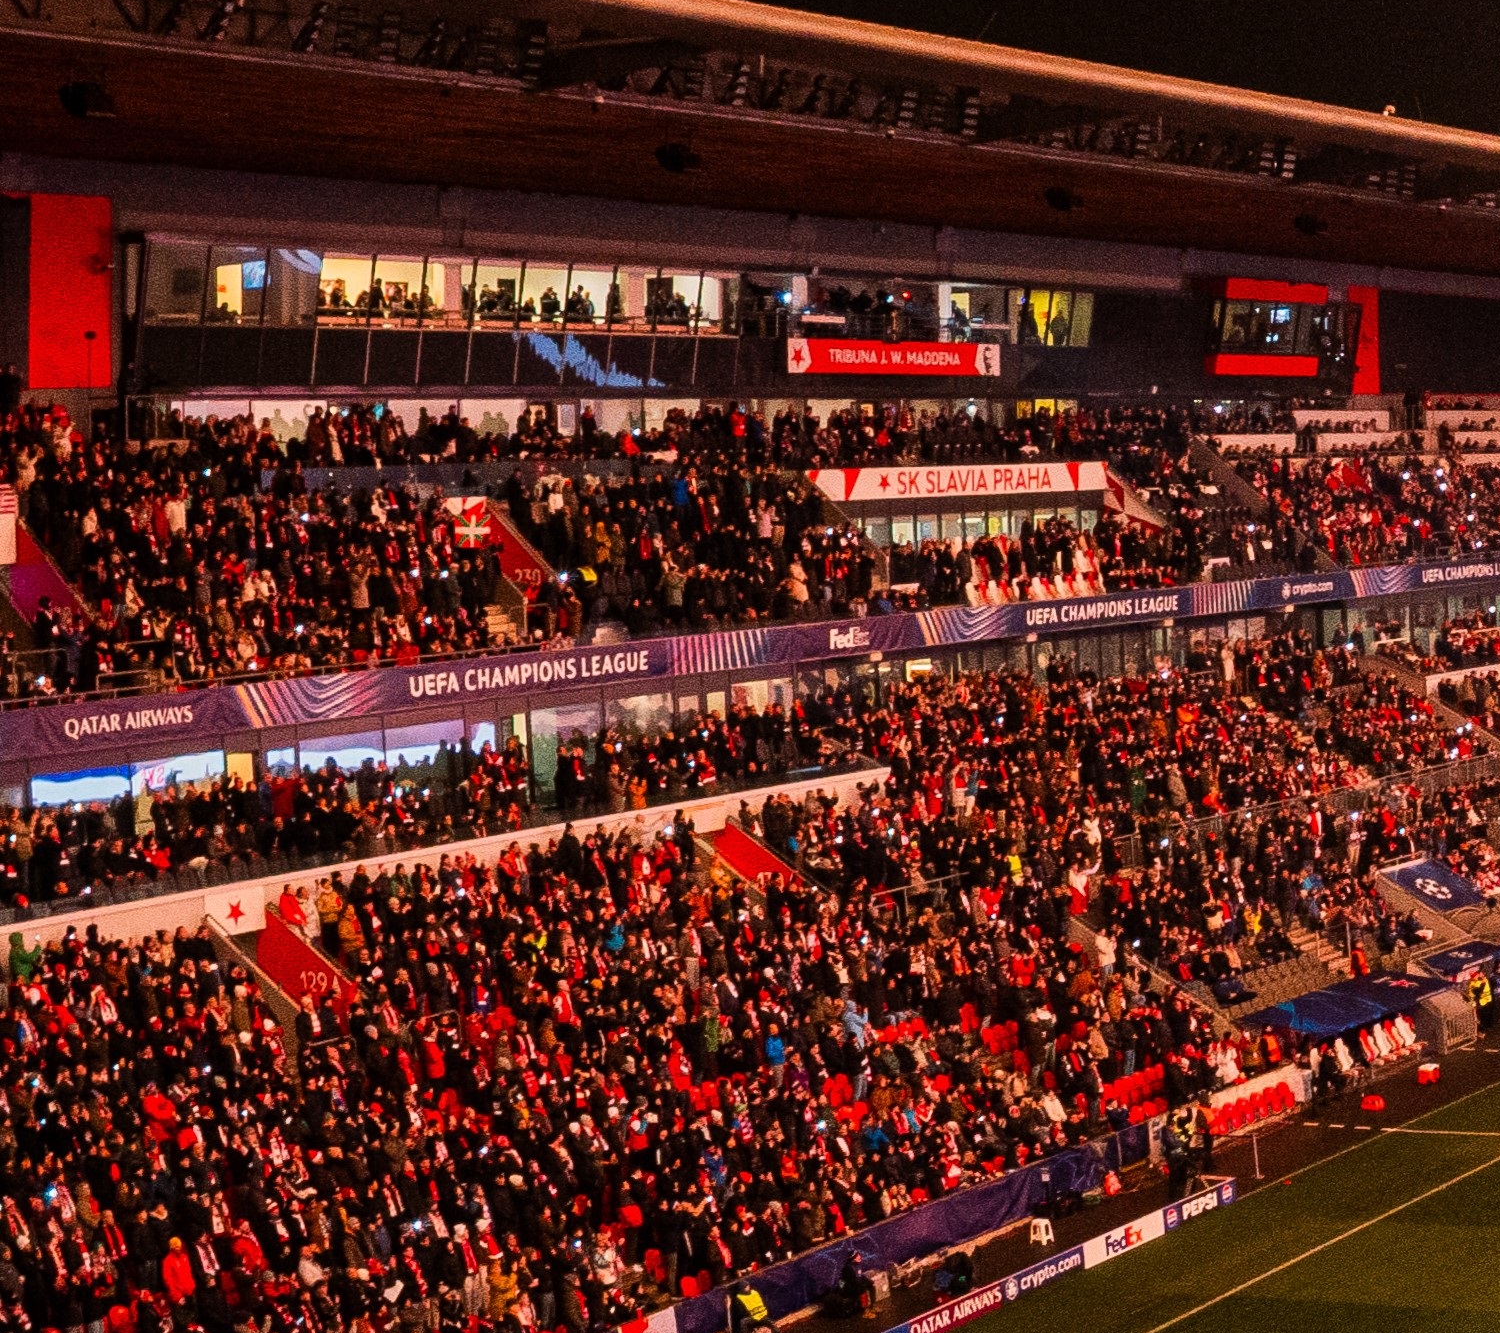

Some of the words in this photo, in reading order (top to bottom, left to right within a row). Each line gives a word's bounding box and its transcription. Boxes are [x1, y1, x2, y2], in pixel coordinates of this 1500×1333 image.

[828, 348, 878, 365] TRIBUNA
[890, 350, 904, 365] W.
[906, 350, 961, 366] MADDENA
[897, 470, 921, 495] SK
[925, 469, 988, 494] SLAVIA
[993, 467, 1051, 491] PRAHA
[1026, 608, 1058, 626] UEFA
[1060, 599, 1133, 623] CHAMPIONS
[1135, 594, 1179, 615] LEAGUE
[409, 671, 460, 698] UEFA
[464, 657, 577, 692] CHAMPIONS
[581, 650, 650, 678] LEAGUE
[64, 713, 122, 741] QATAR
[124, 705, 194, 730] AIRWAYS
[299, 970, 328, 993] 129
[1181, 1191, 1218, 1221] PEPSI
[1105, 1225, 1143, 1257] FedEx
[1020, 1252, 1081, 1292] crypto.com
[952, 1285, 1003, 1321] AIRWAYS
